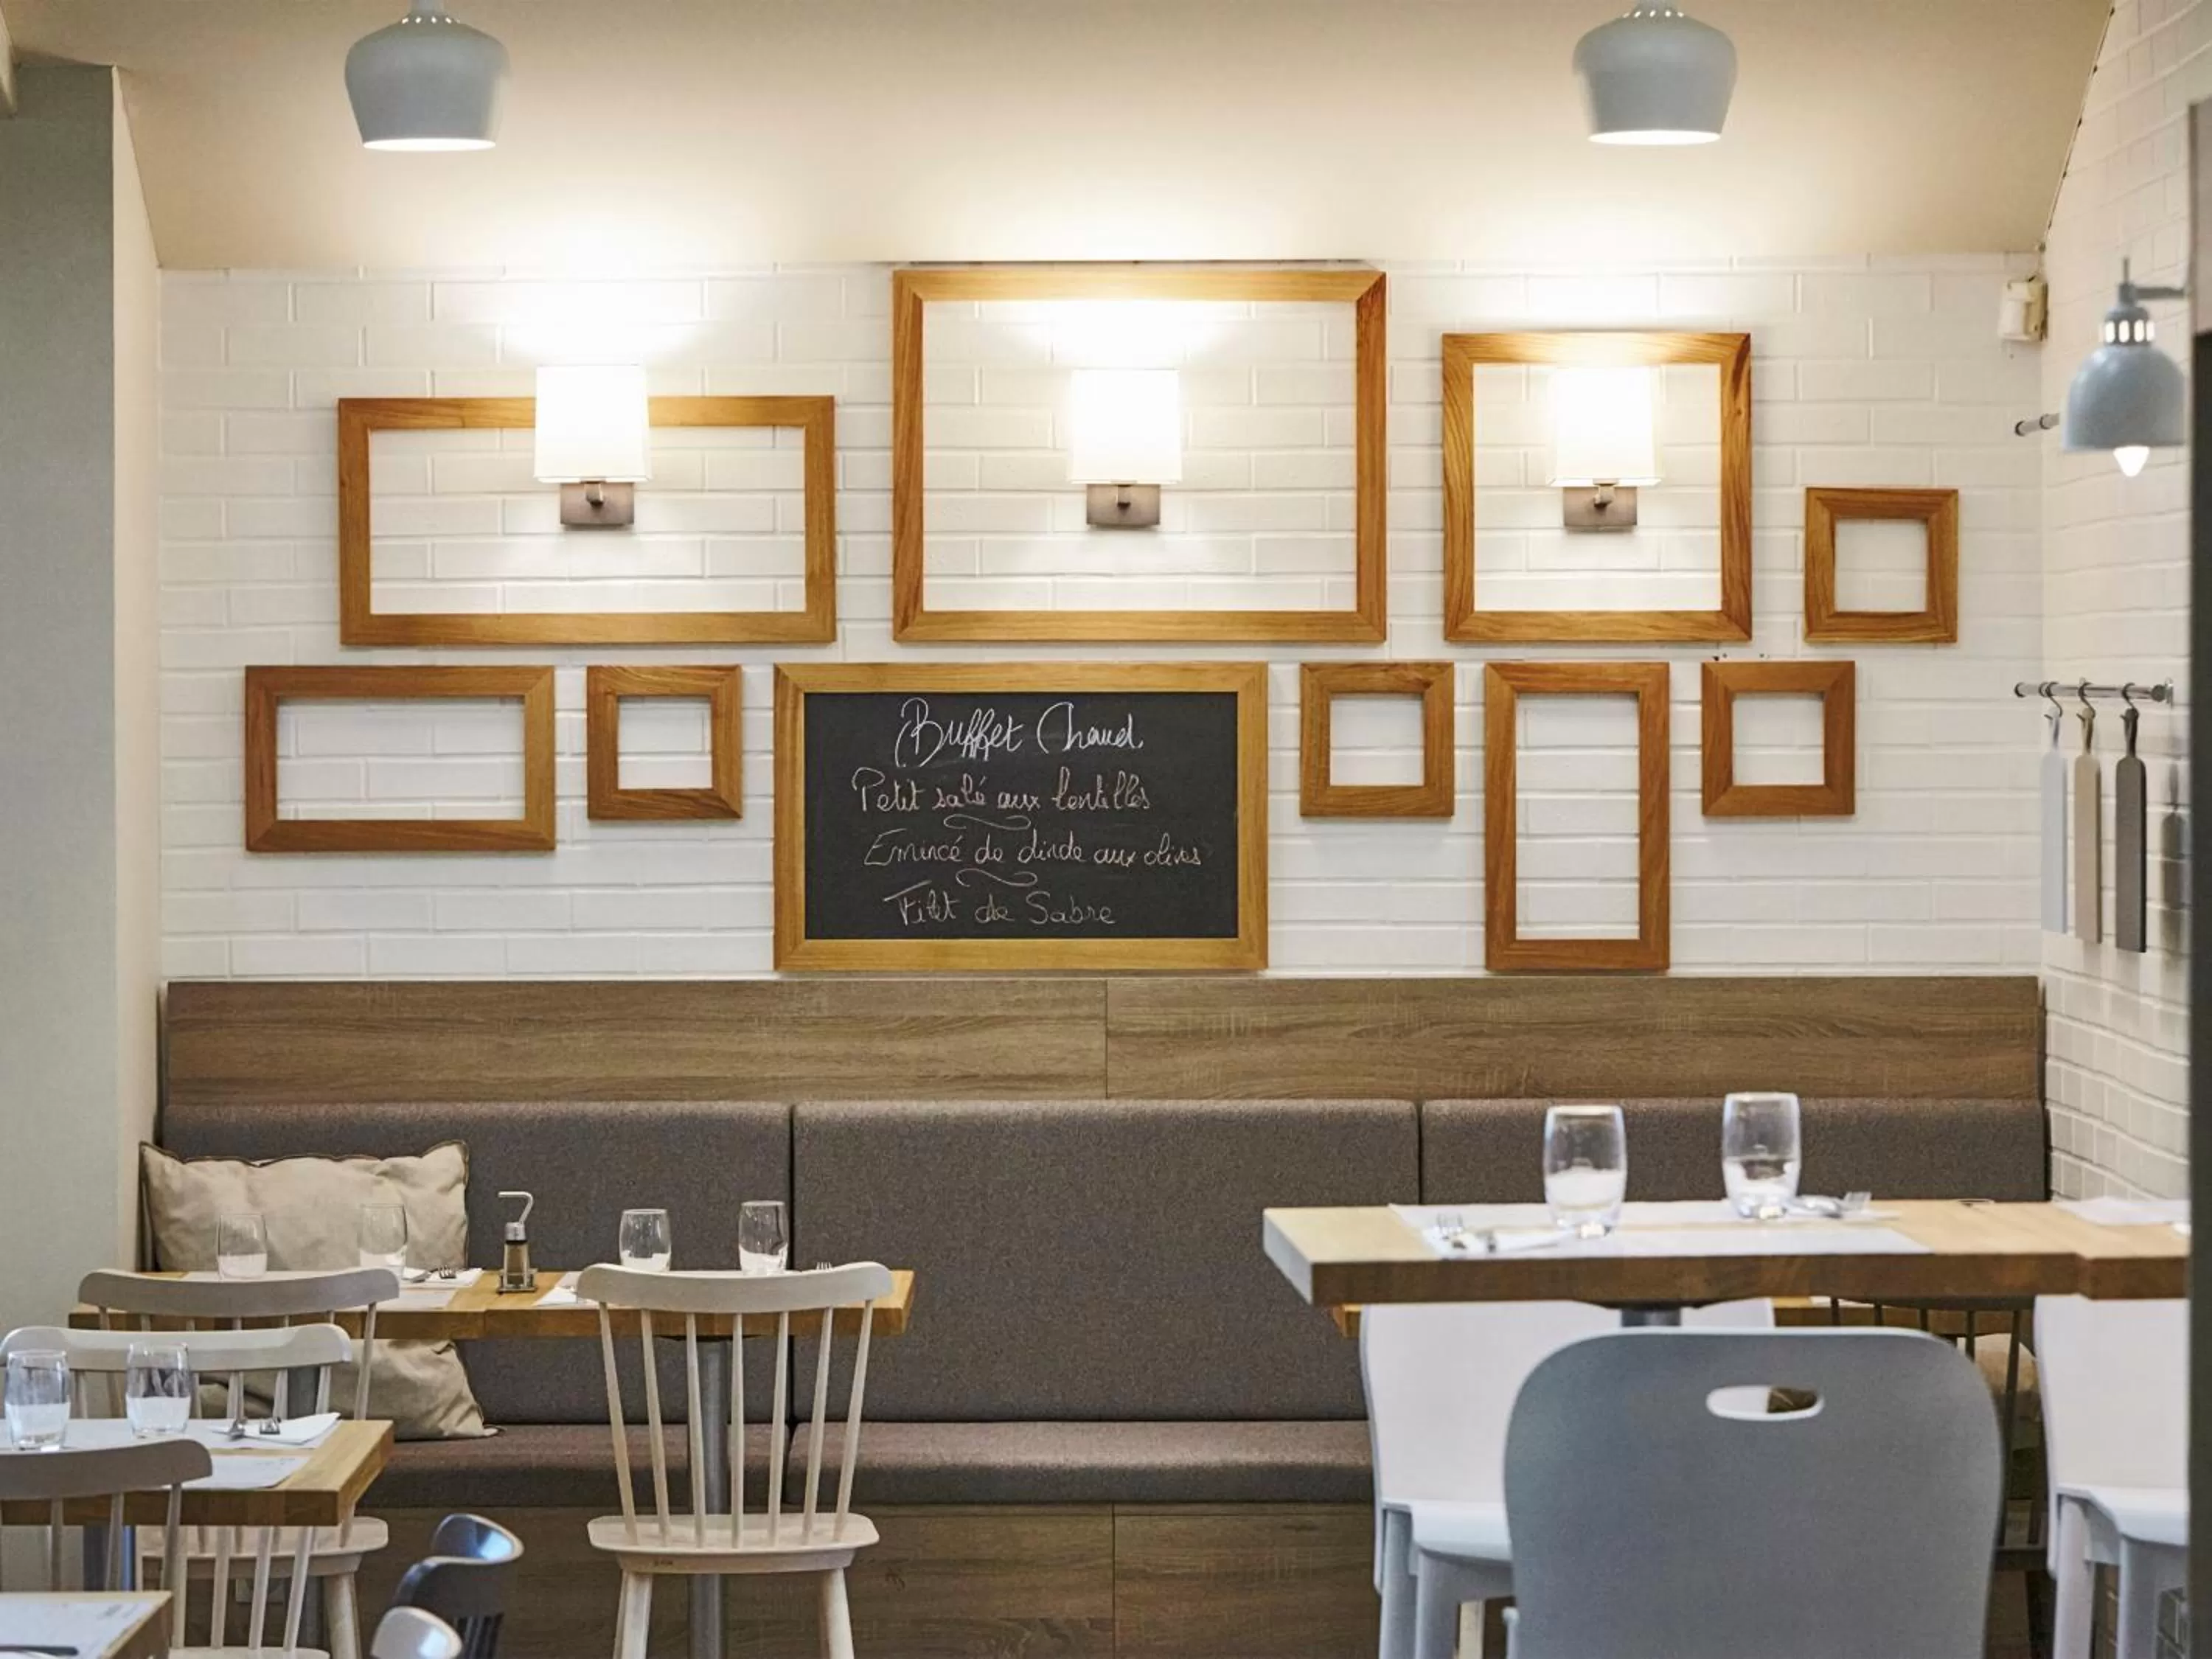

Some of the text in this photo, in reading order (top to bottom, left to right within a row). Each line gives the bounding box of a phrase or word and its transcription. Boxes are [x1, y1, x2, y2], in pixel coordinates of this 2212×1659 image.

[894, 697, 1144, 768] Buffet Chaud
[852, 766, 1151, 812] Petit salé aux lentilles
[863, 828, 963, 866] Emincé
[974, 833, 1005, 865] de
[1017, 827, 1086, 864] dinde
[1093, 847, 1136, 868] aux
[974, 893, 1015, 924] de
[1026, 890, 1116, 925] Sabre
